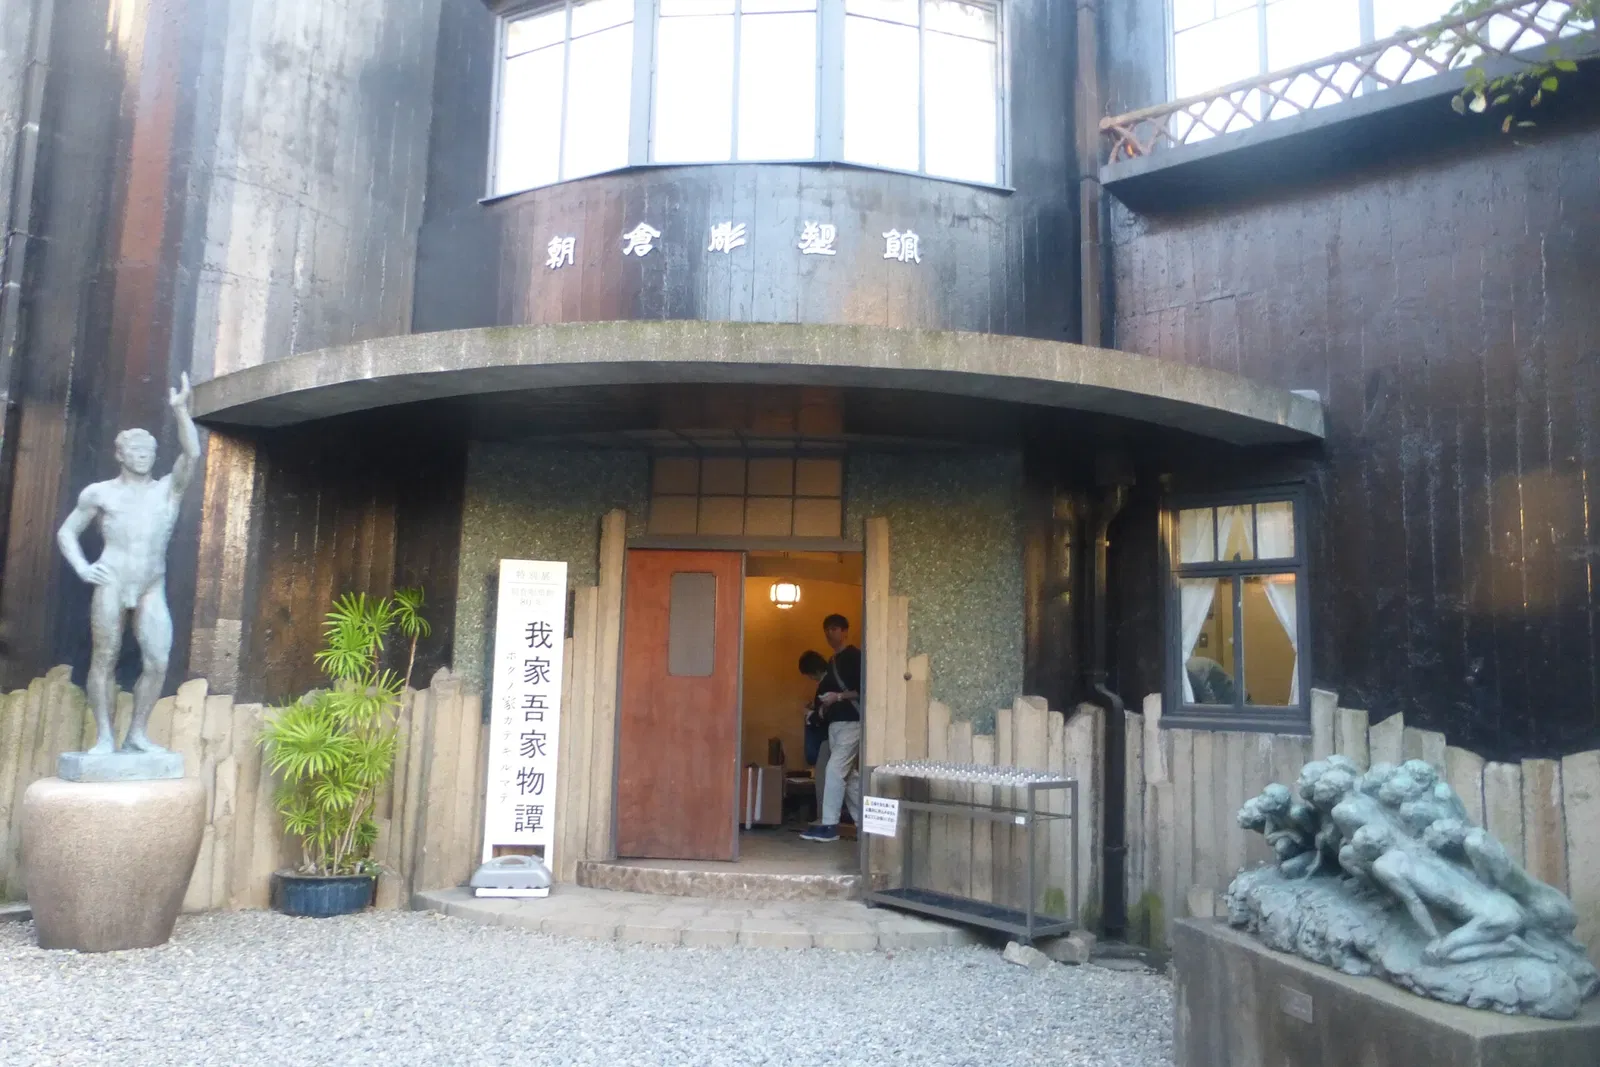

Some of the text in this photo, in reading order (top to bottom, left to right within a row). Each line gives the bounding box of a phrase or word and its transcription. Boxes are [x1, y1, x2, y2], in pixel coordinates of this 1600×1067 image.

[545, 221, 921, 270] 朝倉彫塑館
[514, 620, 553, 833] 我家吾家物譚
